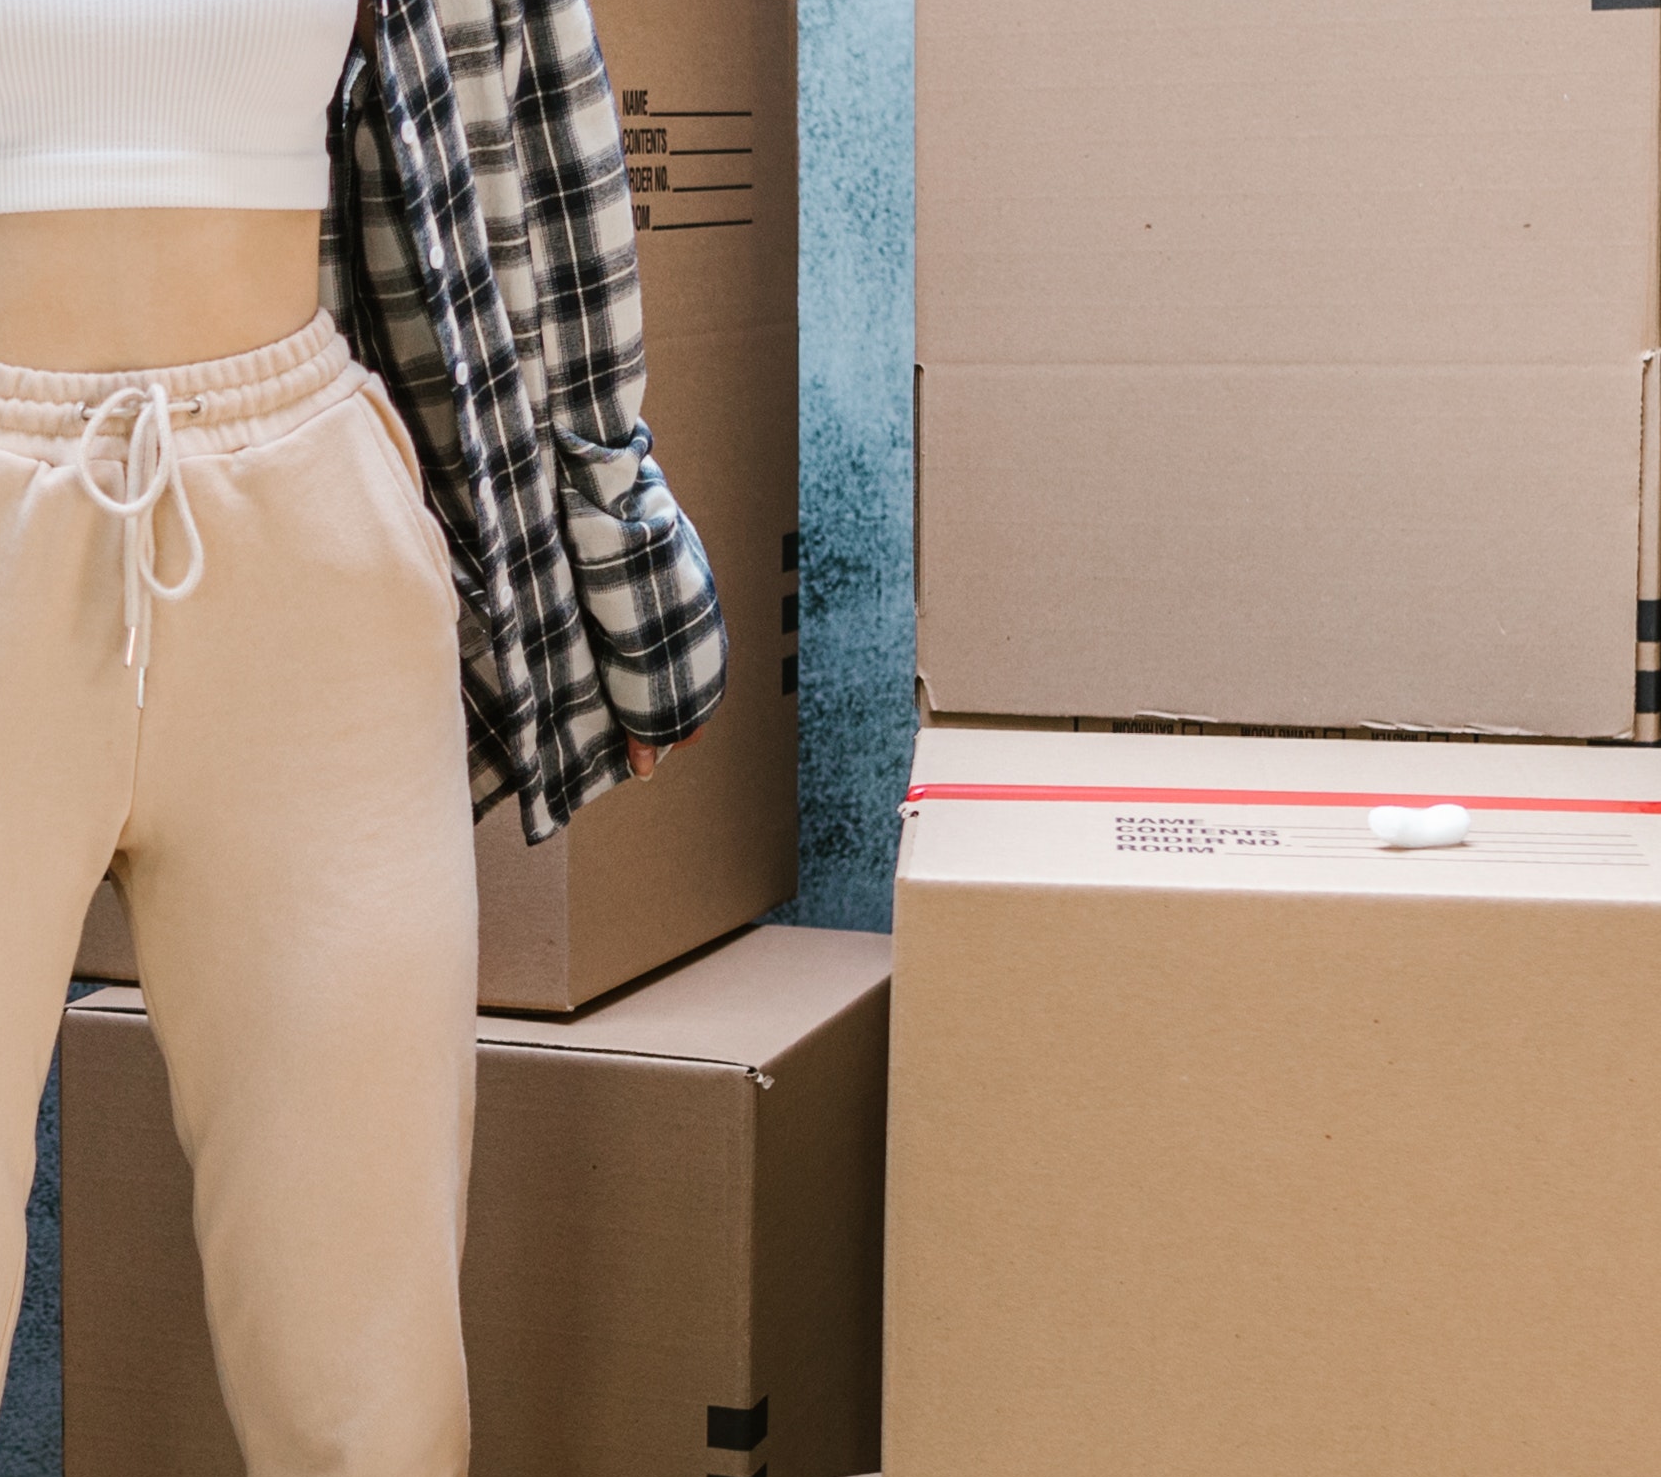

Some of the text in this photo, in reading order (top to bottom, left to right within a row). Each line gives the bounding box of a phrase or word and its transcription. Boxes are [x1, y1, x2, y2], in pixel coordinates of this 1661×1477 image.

[622, 90, 648, 116] NAME
[622, 128, 667, 155] CONTENTS
[628, 166, 670, 193] RDER NO.
[1115, 816, 1204, 825] NAME
[1115, 825, 1278, 837] CONTENTS
[1116, 835, 1292, 847] ORDER NO.
[1116, 843, 1215, 854] ROOM
